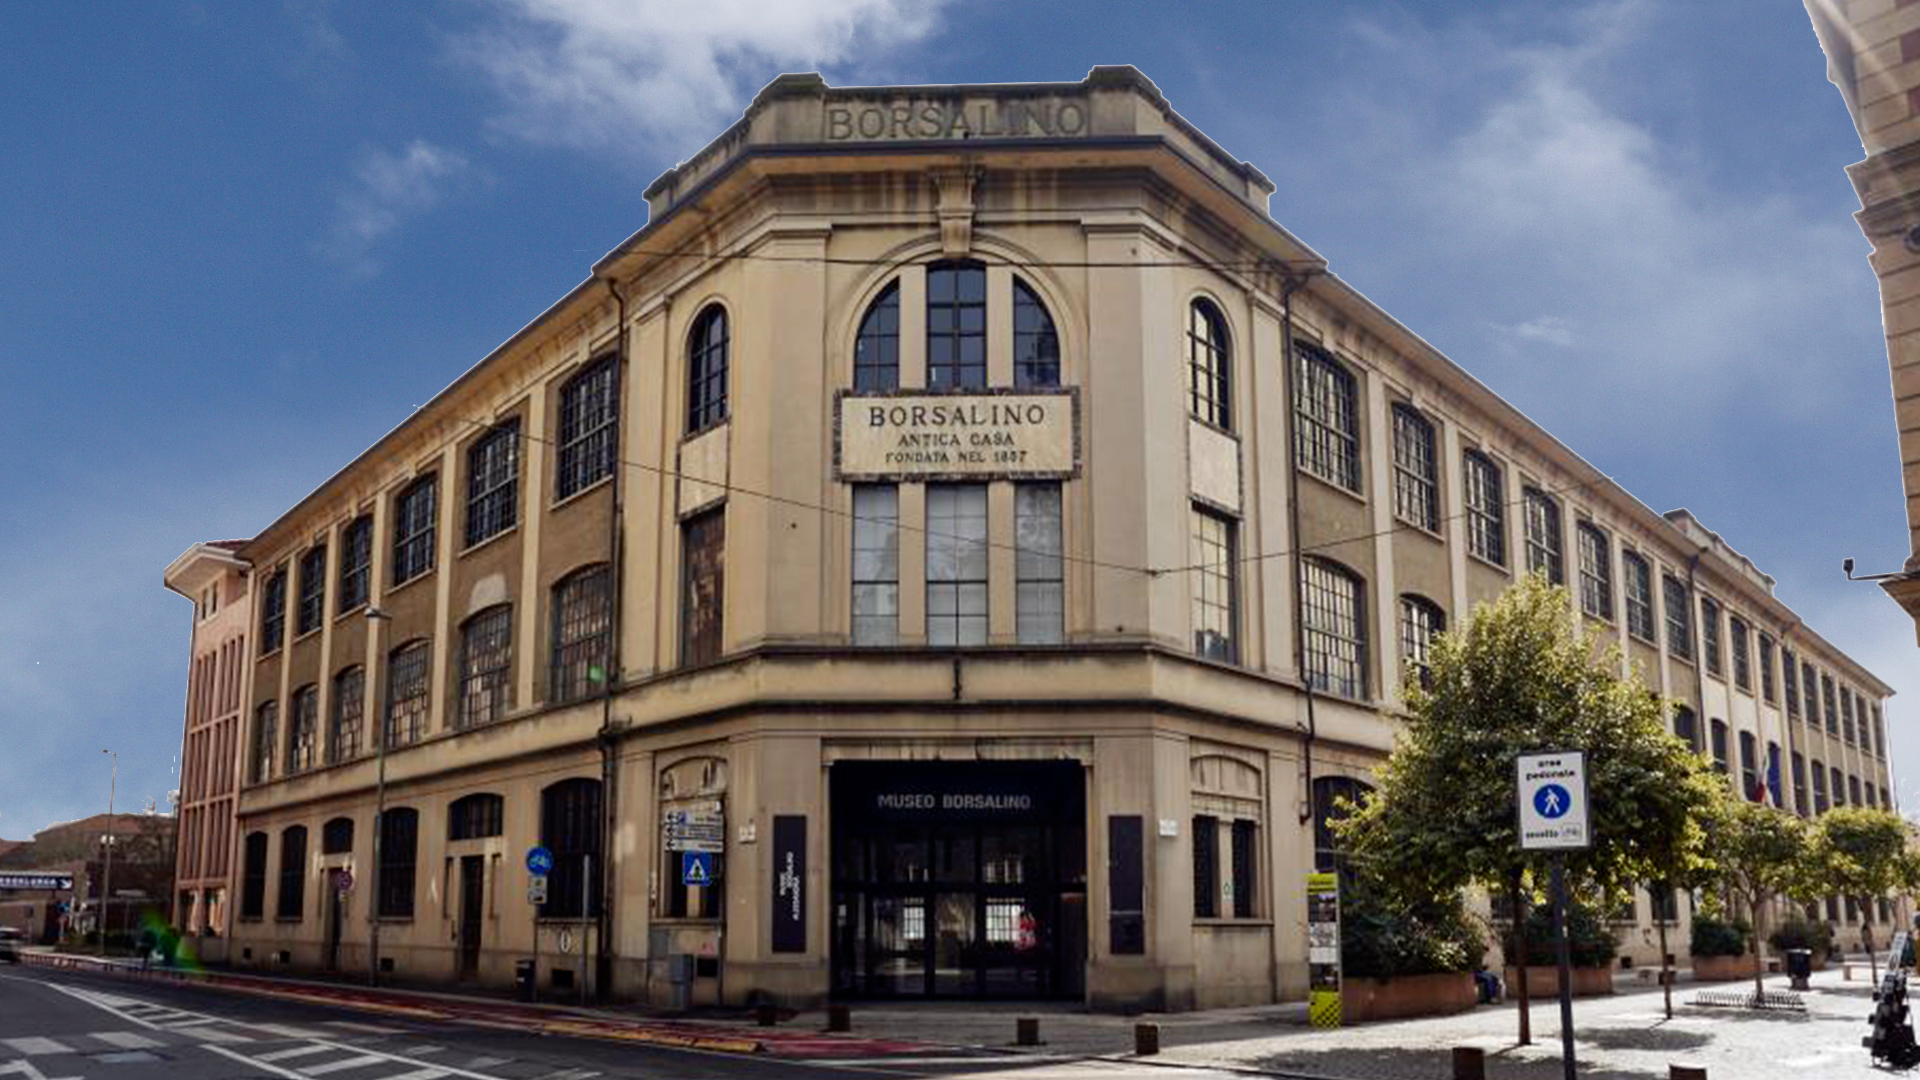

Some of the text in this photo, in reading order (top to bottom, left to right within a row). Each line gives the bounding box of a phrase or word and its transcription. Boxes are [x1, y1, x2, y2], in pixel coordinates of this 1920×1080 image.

[828, 103, 1083, 140] BORSALINO
[868, 403, 1045, 427] BORSALINO
[898, 431, 1015, 447] ANTICA CASA
[885, 451, 950, 463] FONDATA
[957, 450, 987, 463] NEL
[877, 793, 1032, 809] MUSEO BORSALINO
